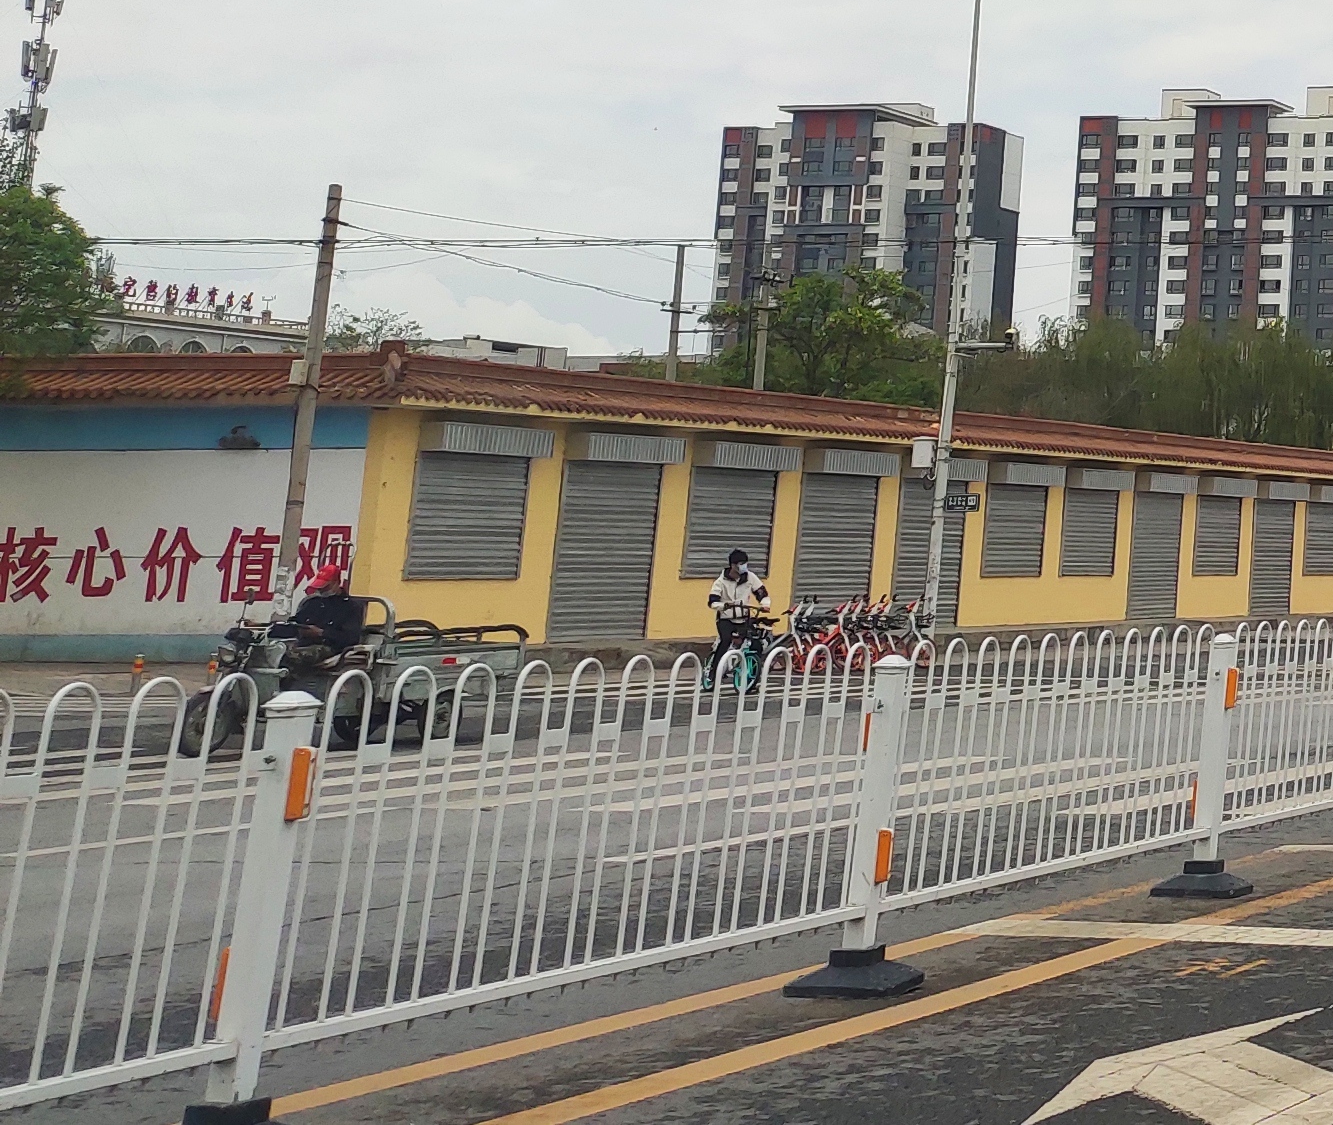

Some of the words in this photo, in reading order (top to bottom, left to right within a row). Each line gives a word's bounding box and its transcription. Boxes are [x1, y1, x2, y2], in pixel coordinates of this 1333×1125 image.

[0, 525, 352, 603] 核心价值观
